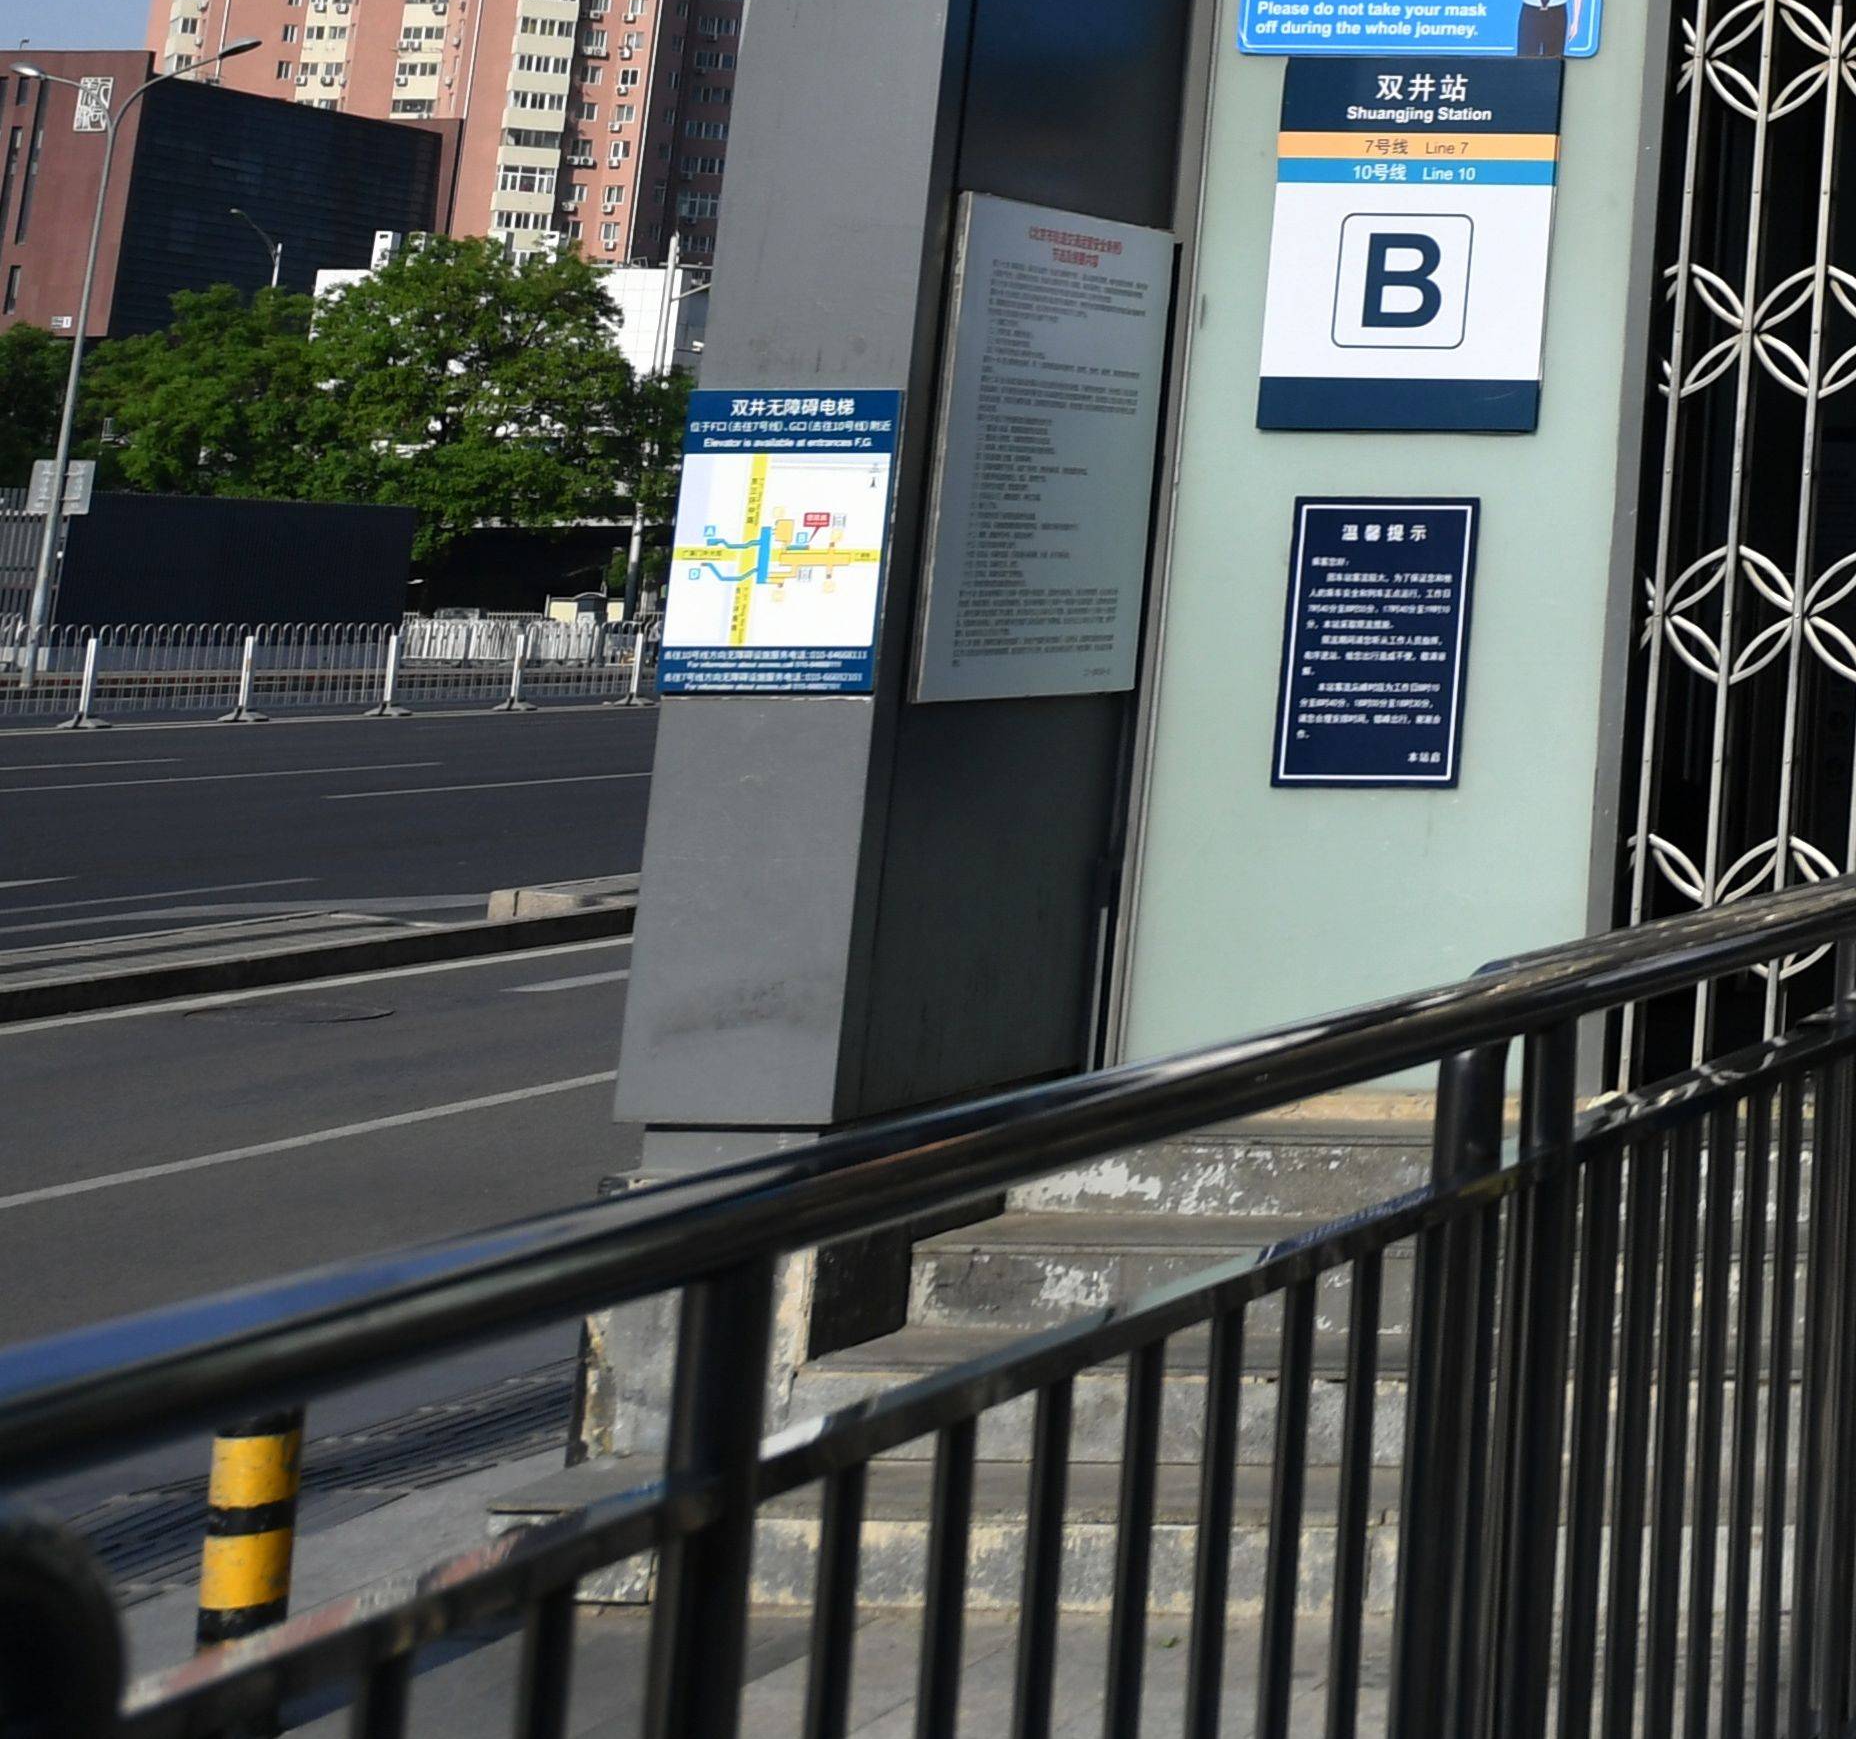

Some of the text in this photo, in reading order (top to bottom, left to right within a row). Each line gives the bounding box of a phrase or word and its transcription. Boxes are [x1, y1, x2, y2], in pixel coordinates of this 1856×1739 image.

[1257, 1, 1487, 20] Please do not take your mask
[1255, 20, 1479, 39] off during the whole journey.
[1375, 74, 1469, 103] 双井站
[1346, 106, 1493, 123] Shuangjing Station
[1365, 139, 1470, 155] 7号线 Line 7
[1352, 164, 1476, 181] 10号线 Line 10
[1361, 232, 1443, 329] B
[730, 398, 856, 417] 双井无障碍电梯
